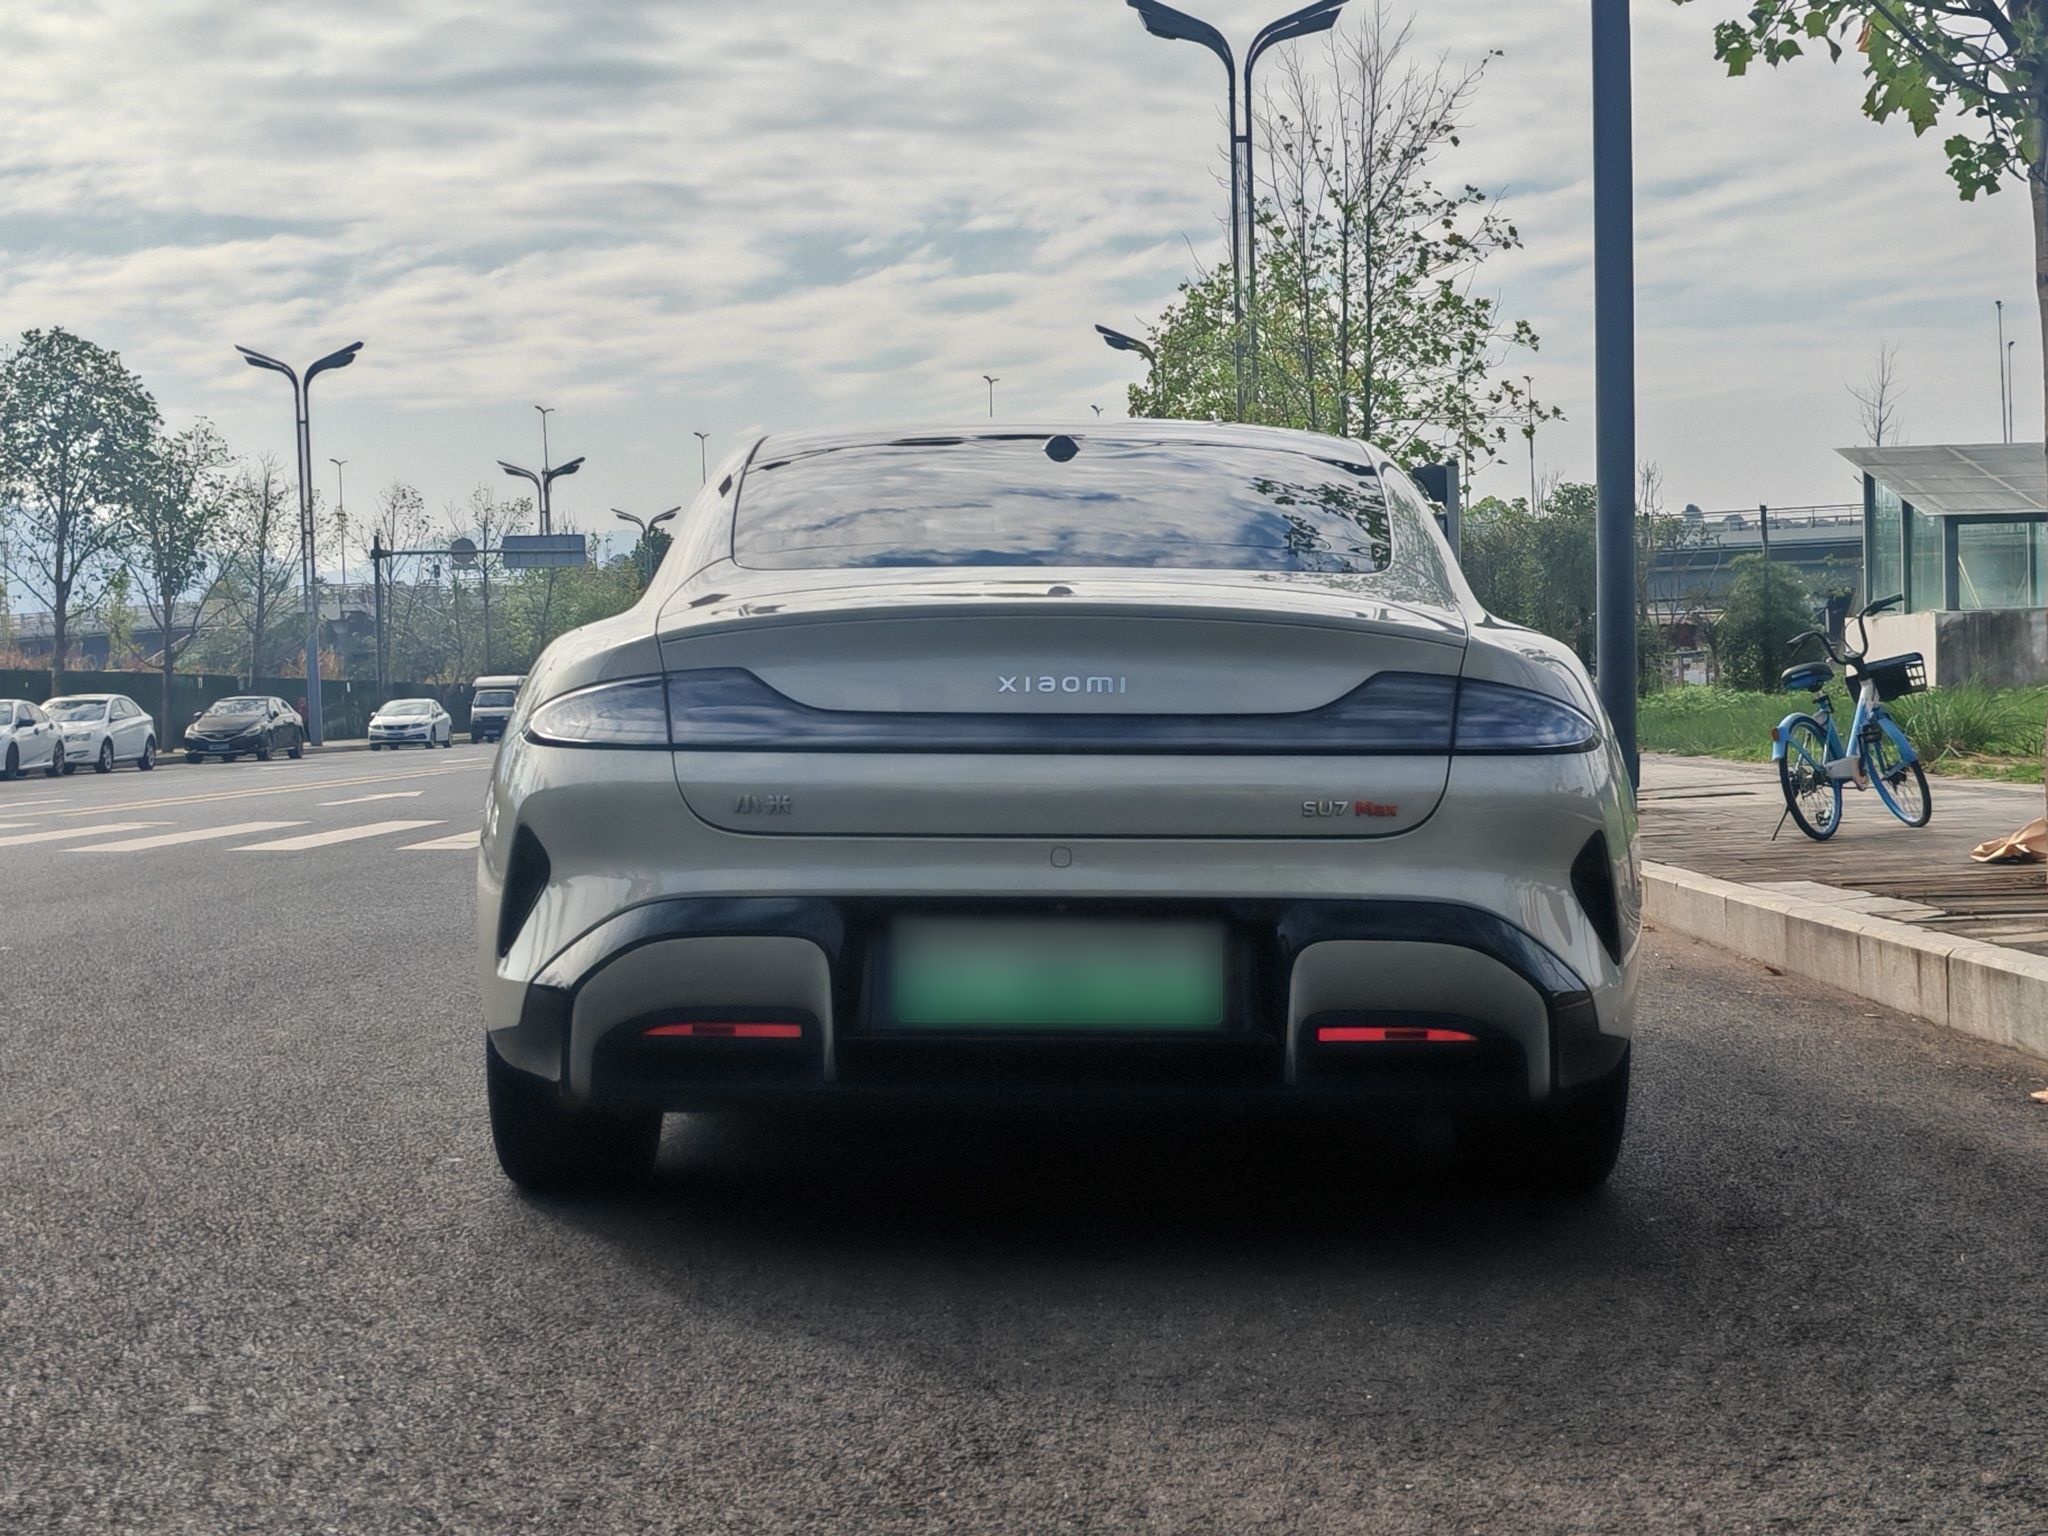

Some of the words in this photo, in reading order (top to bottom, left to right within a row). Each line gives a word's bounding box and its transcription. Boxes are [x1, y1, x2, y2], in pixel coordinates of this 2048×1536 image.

[998, 676, 1127, 694] xiaomi
[735, 794, 792, 816] 小米
[1302, 800, 1349, 817] SU7
[1355, 801, 1398, 817] Max
